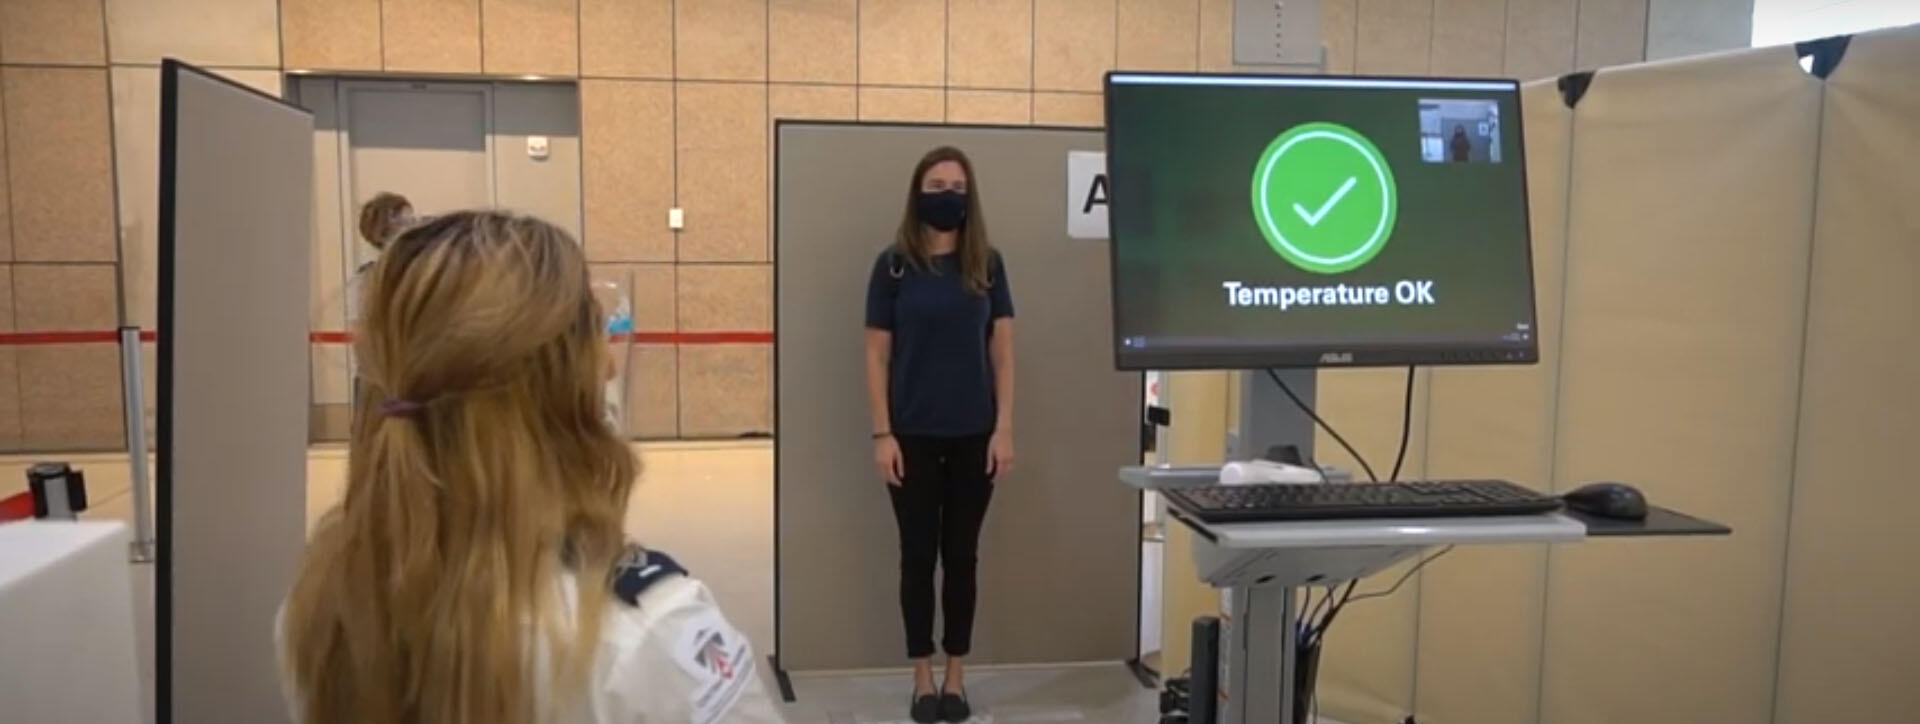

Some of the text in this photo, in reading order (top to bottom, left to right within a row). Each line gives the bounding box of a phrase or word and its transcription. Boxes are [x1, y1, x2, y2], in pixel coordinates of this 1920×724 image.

[1083, 174, 1108, 214] A
[1223, 280, 1434, 310] Temperature OK
